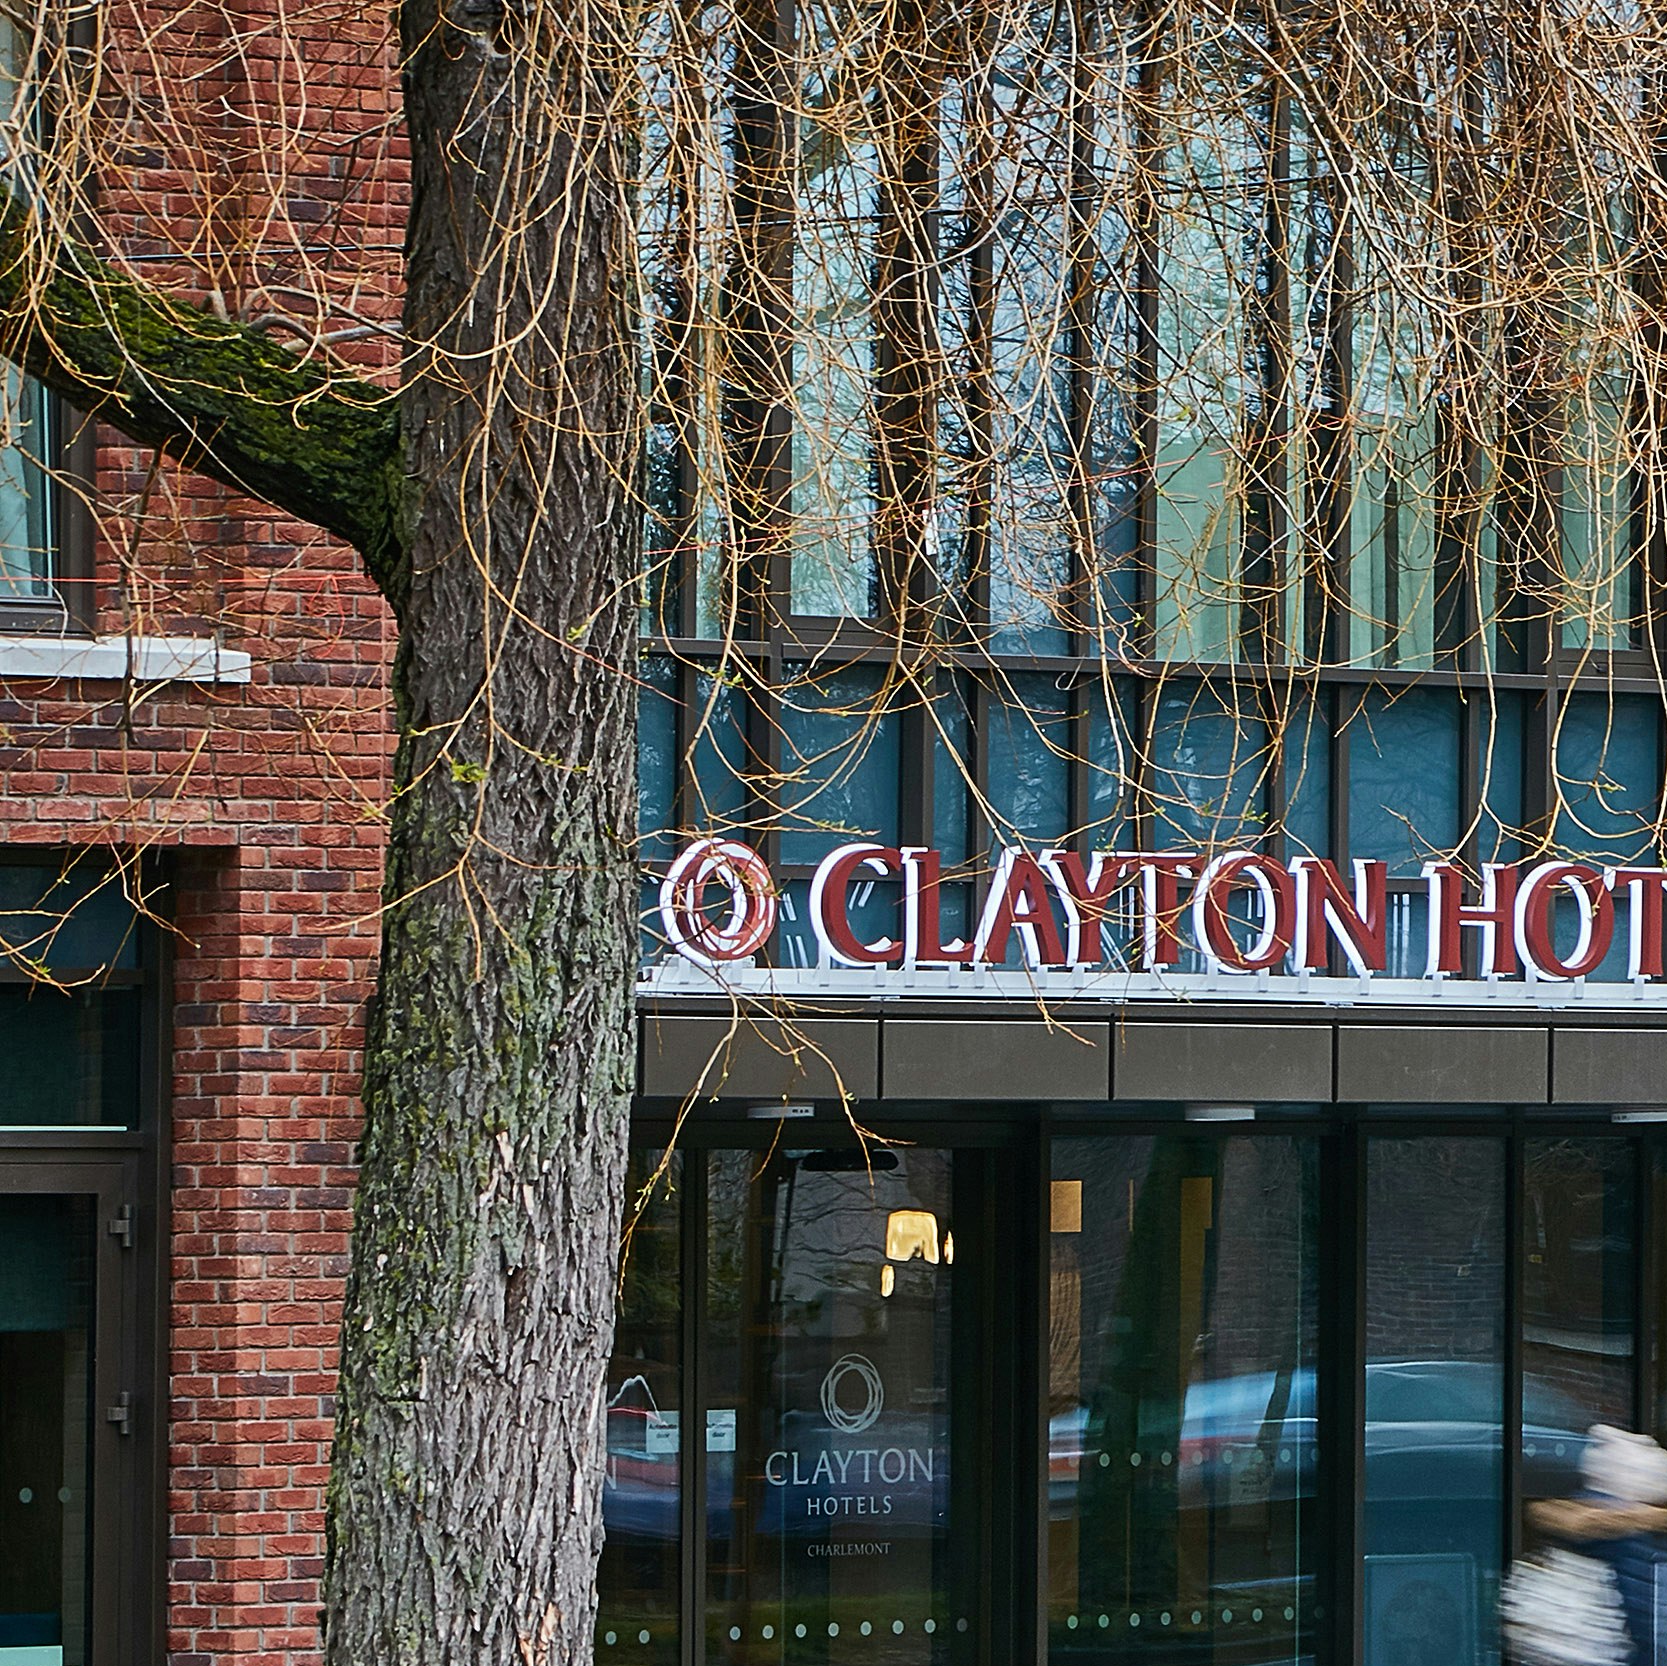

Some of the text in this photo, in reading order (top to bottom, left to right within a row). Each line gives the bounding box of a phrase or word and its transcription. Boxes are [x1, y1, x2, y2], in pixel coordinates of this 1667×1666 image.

[809, 842, 1387, 977] CLAYTON
[765, 1447, 933, 1486] CLAYTON
[806, 1495, 893, 1515] HOTELS
[806, 1542, 891, 1558] CHARLEMONT
